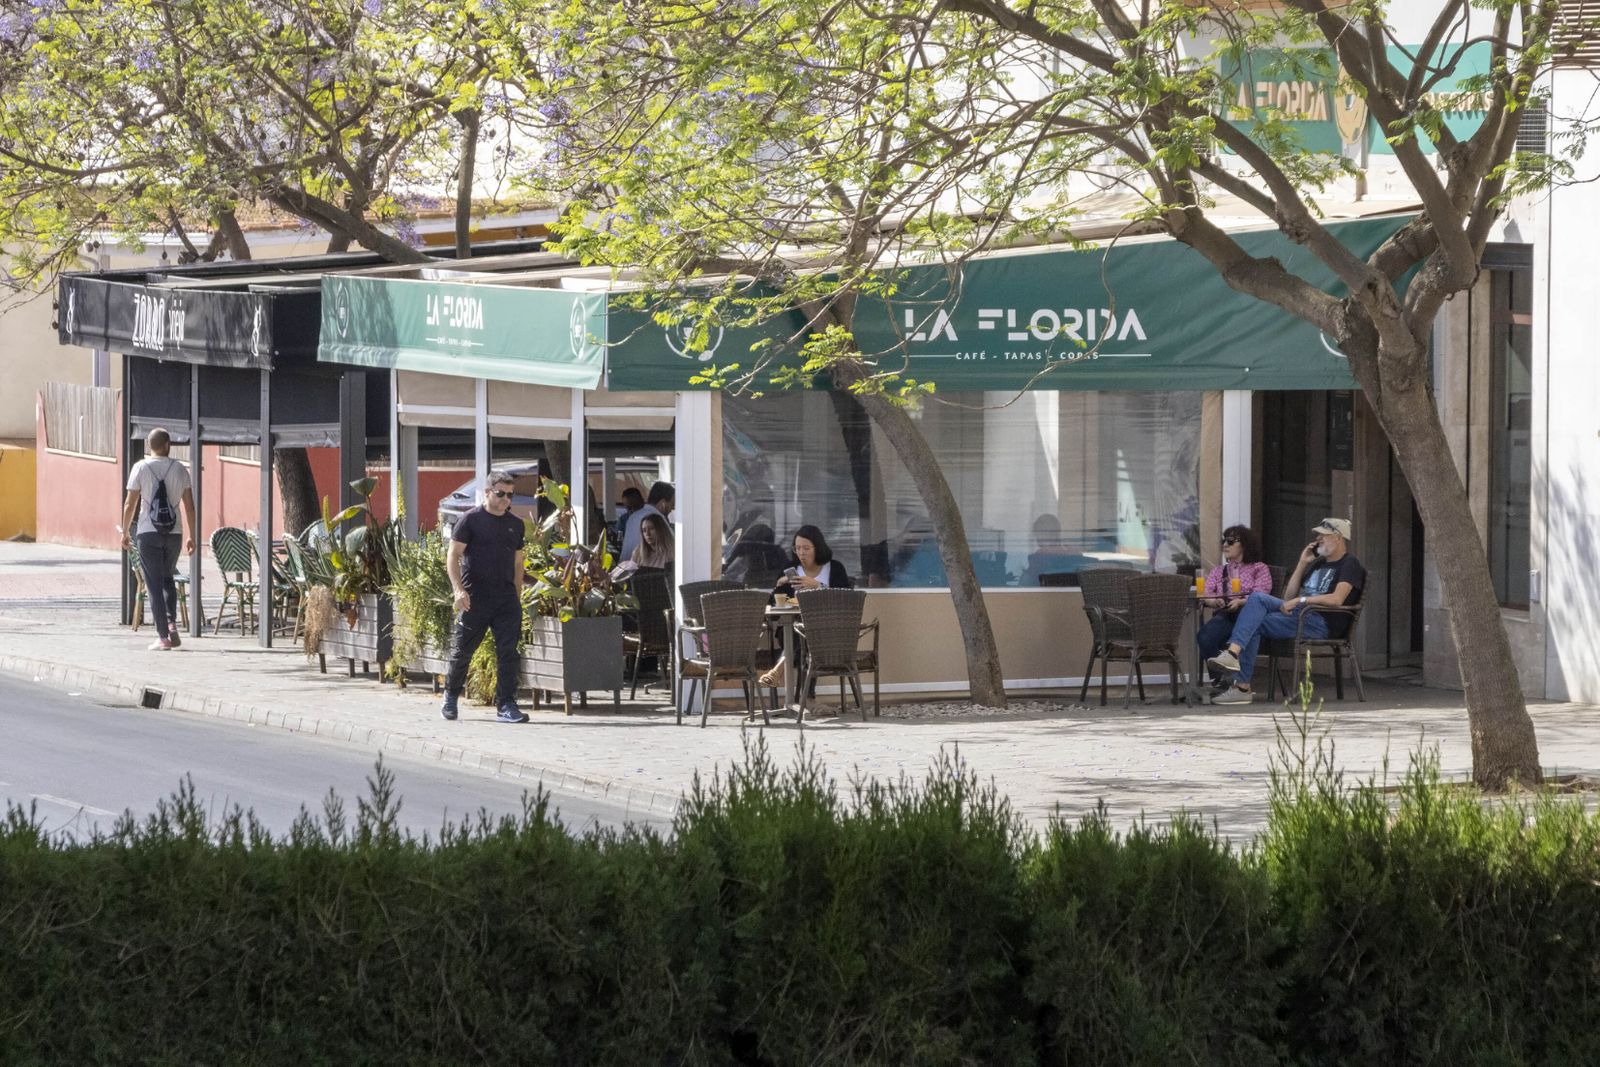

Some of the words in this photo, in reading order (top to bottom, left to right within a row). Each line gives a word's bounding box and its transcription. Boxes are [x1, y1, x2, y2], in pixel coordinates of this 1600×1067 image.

[1256, 81, 1328, 121] FLORIDA
[132, 293, 165, 351] ZORRO
[426, 293, 440, 326] LA
[443, 295, 484, 330] FLORIDA
[905, 308, 959, 341] LA
[978, 308, 1147, 341] FLORIDA
[955, 350, 987, 360] CAFÉ
[1004, 352, 1042, 360] TAPAS
